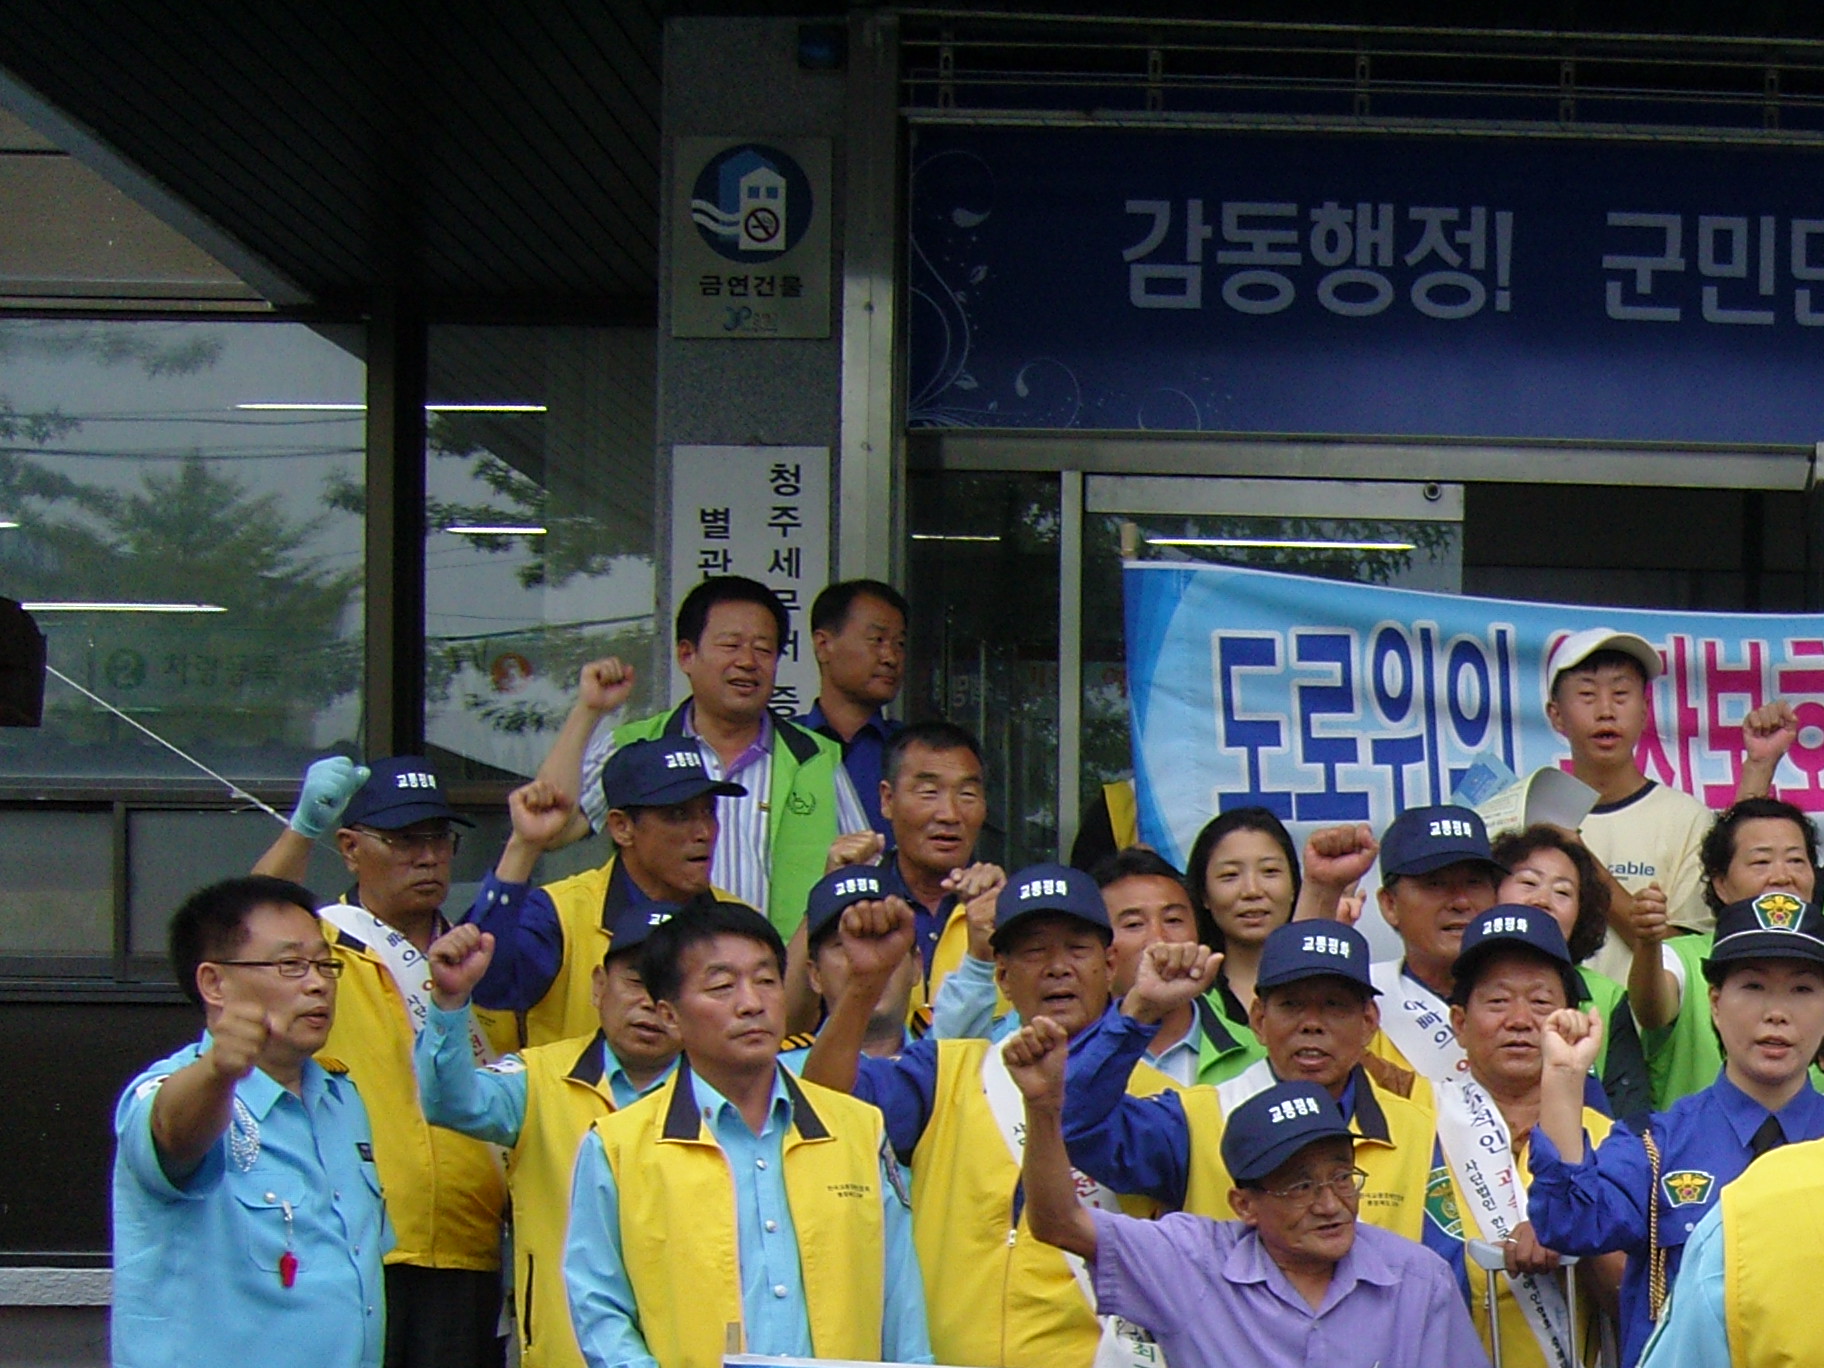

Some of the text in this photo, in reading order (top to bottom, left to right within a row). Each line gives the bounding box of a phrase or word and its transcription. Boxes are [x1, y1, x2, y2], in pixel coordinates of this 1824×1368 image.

[1121, 199, 1514, 320] 감동행정!
[700, 275, 803, 297] 금연건물
[1430, 820, 1472, 838] 교통평화
[834, 878, 880, 896] 교통평화
[1019, 880, 1067, 900] 교통평화
[1482, 916, 1528, 935] 교통평화
[1302, 936, 1350, 959] 교통평화
[1268, 1096, 1320, 1124] 교통평화
